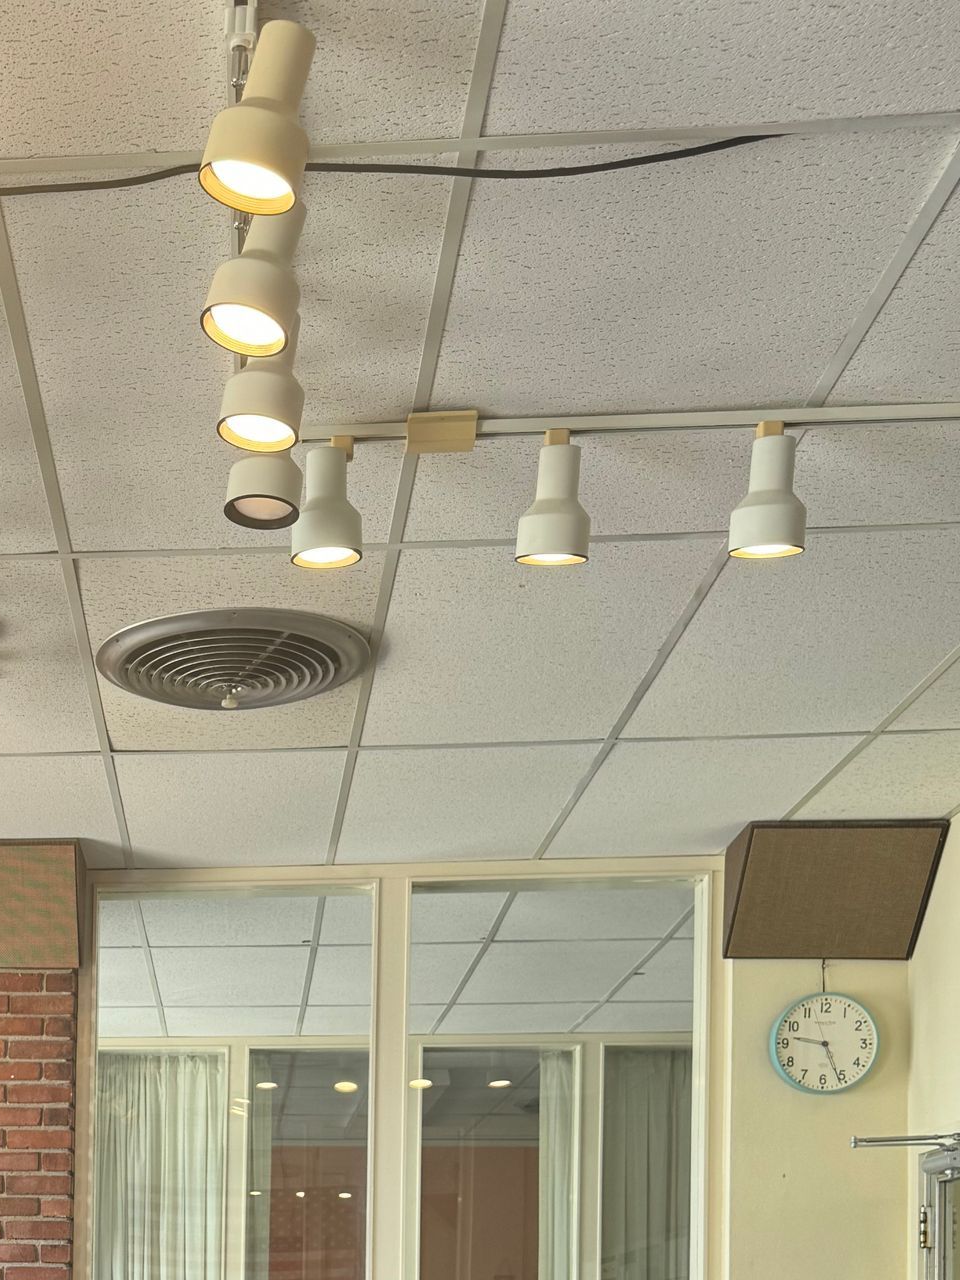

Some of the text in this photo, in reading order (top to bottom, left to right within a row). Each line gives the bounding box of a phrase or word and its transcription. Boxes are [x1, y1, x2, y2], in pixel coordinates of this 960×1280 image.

[803, 1007, 811, 1019] 11
[820, 1002, 832, 1014] 12
[788, 1020, 799, 1032] 10
[854, 1020, 862, 1031] 2
[781, 1038, 789, 1049] 9
[860, 1038, 868, 1049] 3
[786, 1056, 794, 1067] 8
[853, 1057, 860, 1068] 4
[801, 1069, 808, 1080] 7
[819, 1074, 827, 1085] 6
[838, 1070, 846, 1081] 5
